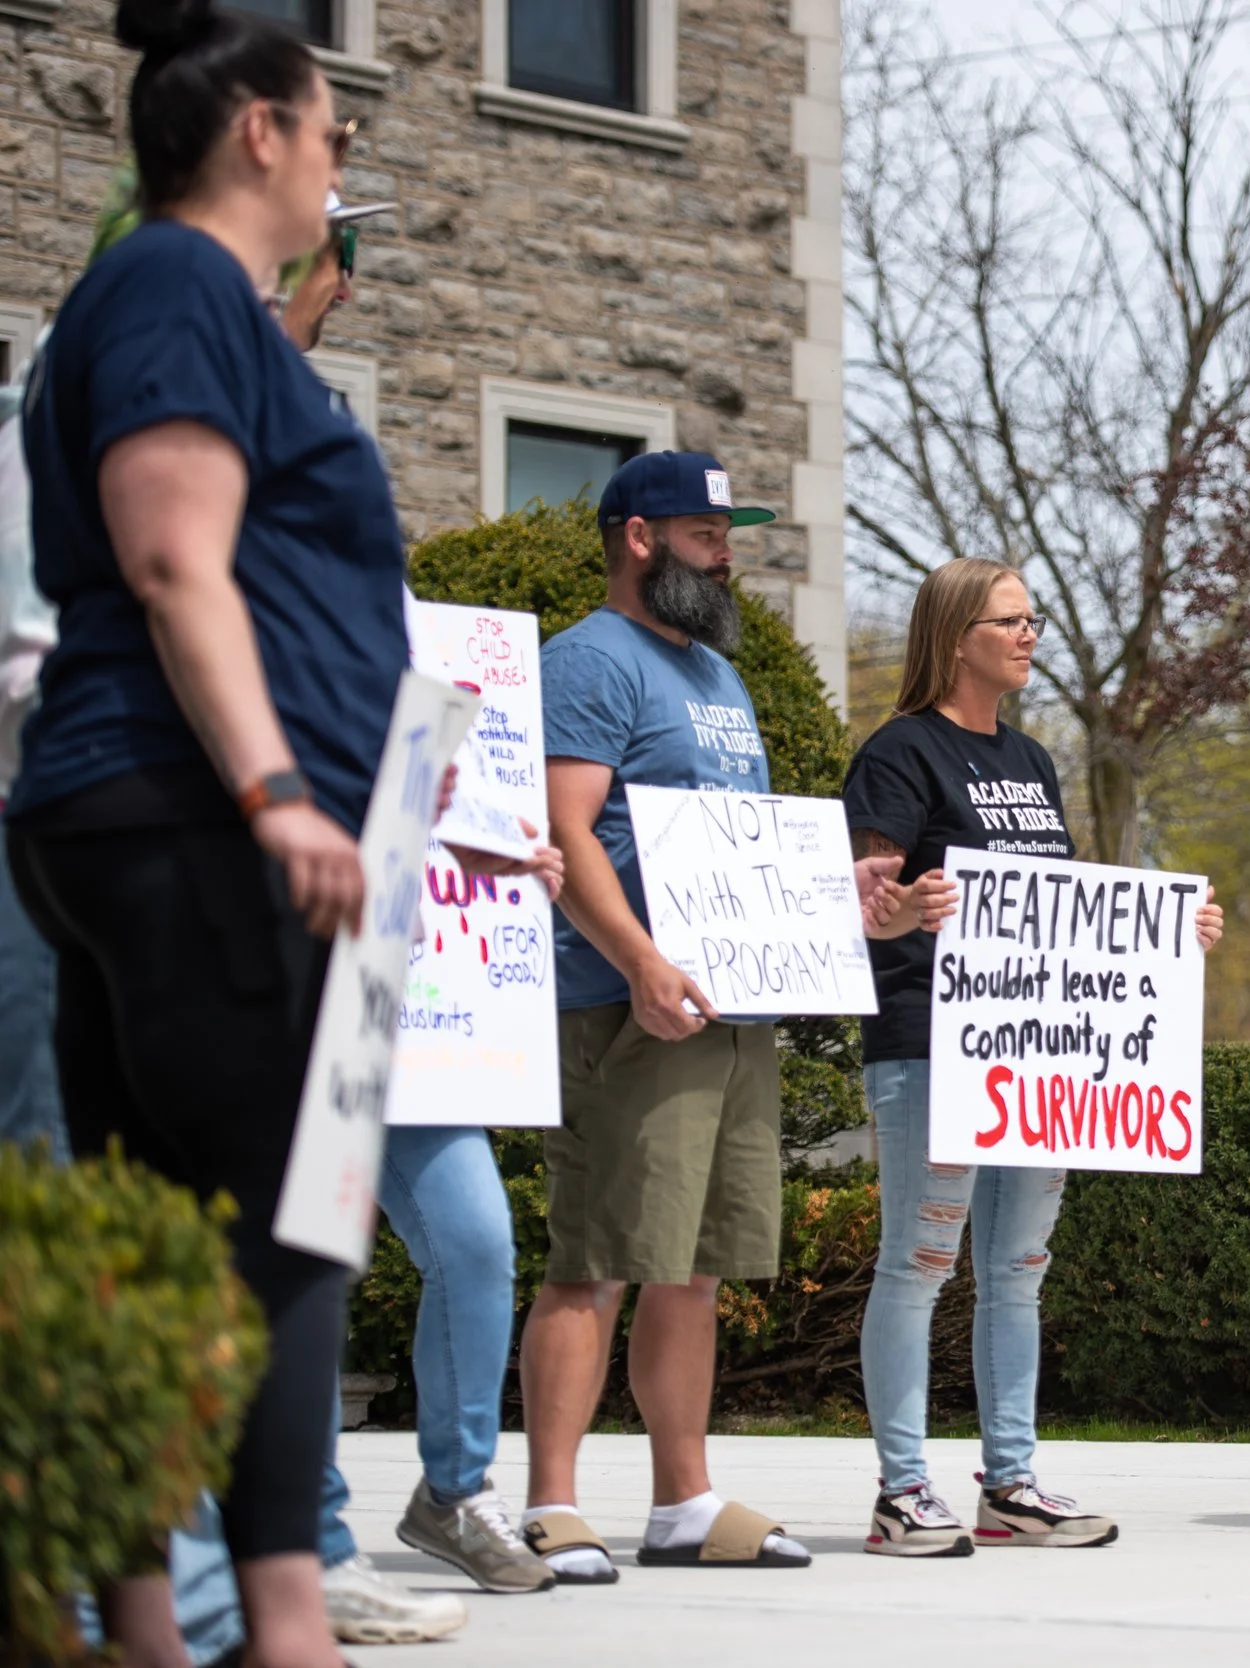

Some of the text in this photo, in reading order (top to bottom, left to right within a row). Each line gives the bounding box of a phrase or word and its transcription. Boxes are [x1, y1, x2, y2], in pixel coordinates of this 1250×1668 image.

[475, 617, 504, 636] STOP
[466, 637, 511, 664] CHILD
[482, 648, 527, 686] ABUSE!
[482, 705, 508, 730] Stop
[477, 726, 528, 746] nstitutional
[693, 723, 720, 751] IVY
[483, 745, 515, 761] HILD
[966, 779, 1050, 806] ACADEMY
[698, 795, 783, 855] NOT
[975, 806, 1065, 832] IVY RIDGE
[986, 839, 1069, 855] #ISeeYouSurvivor
[664, 863, 817, 927] With The
[956, 869, 1198, 958] TREATMENT
[701, 936, 842, 1005] PROGRAM
[1062, 958, 1127, 1002] leave
[1139, 975, 1157, 999] a
[960, 1011, 1157, 1082] community of
[975, 1064, 1193, 1162] SURVIVORS
